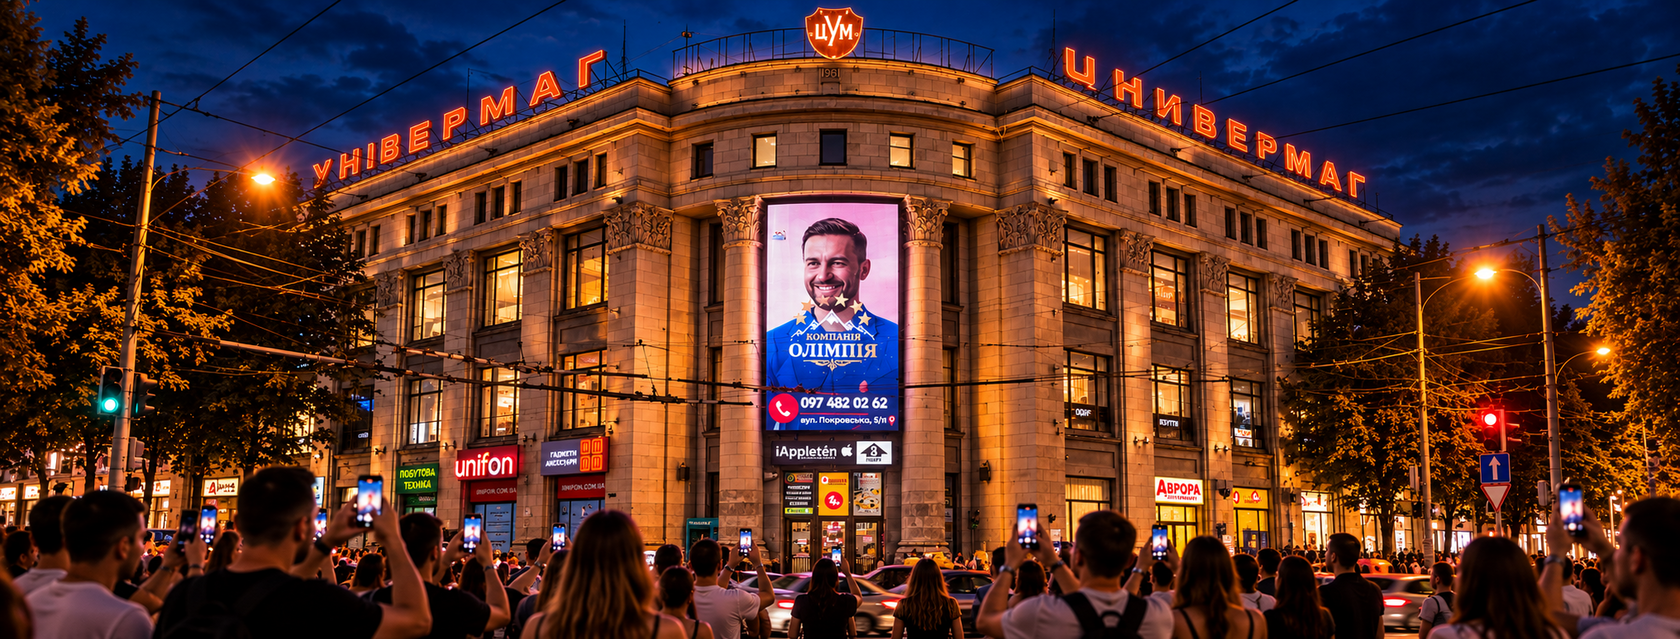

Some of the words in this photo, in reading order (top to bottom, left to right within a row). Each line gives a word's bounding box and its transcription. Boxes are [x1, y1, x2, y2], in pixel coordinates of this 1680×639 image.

[815, 15, 853, 46] ЦУМ
[821, 68, 840, 78] 1961
[312, 49, 607, 190] УНІВЕРМАГ
[806, 333, 861, 341] КОМПАНІЯ
[788, 343, 878, 358] ОЛІМПІЯ
[800, 397, 824, 409] 097
[826, 397, 850, 409] 482
[852, 397, 869, 409] 02
[871, 397, 888, 409] 62
[775, 444, 837, 460] iAppletén
[455, 451, 513, 478] unifon
[399, 467, 436, 479] ПОБУТОВА
